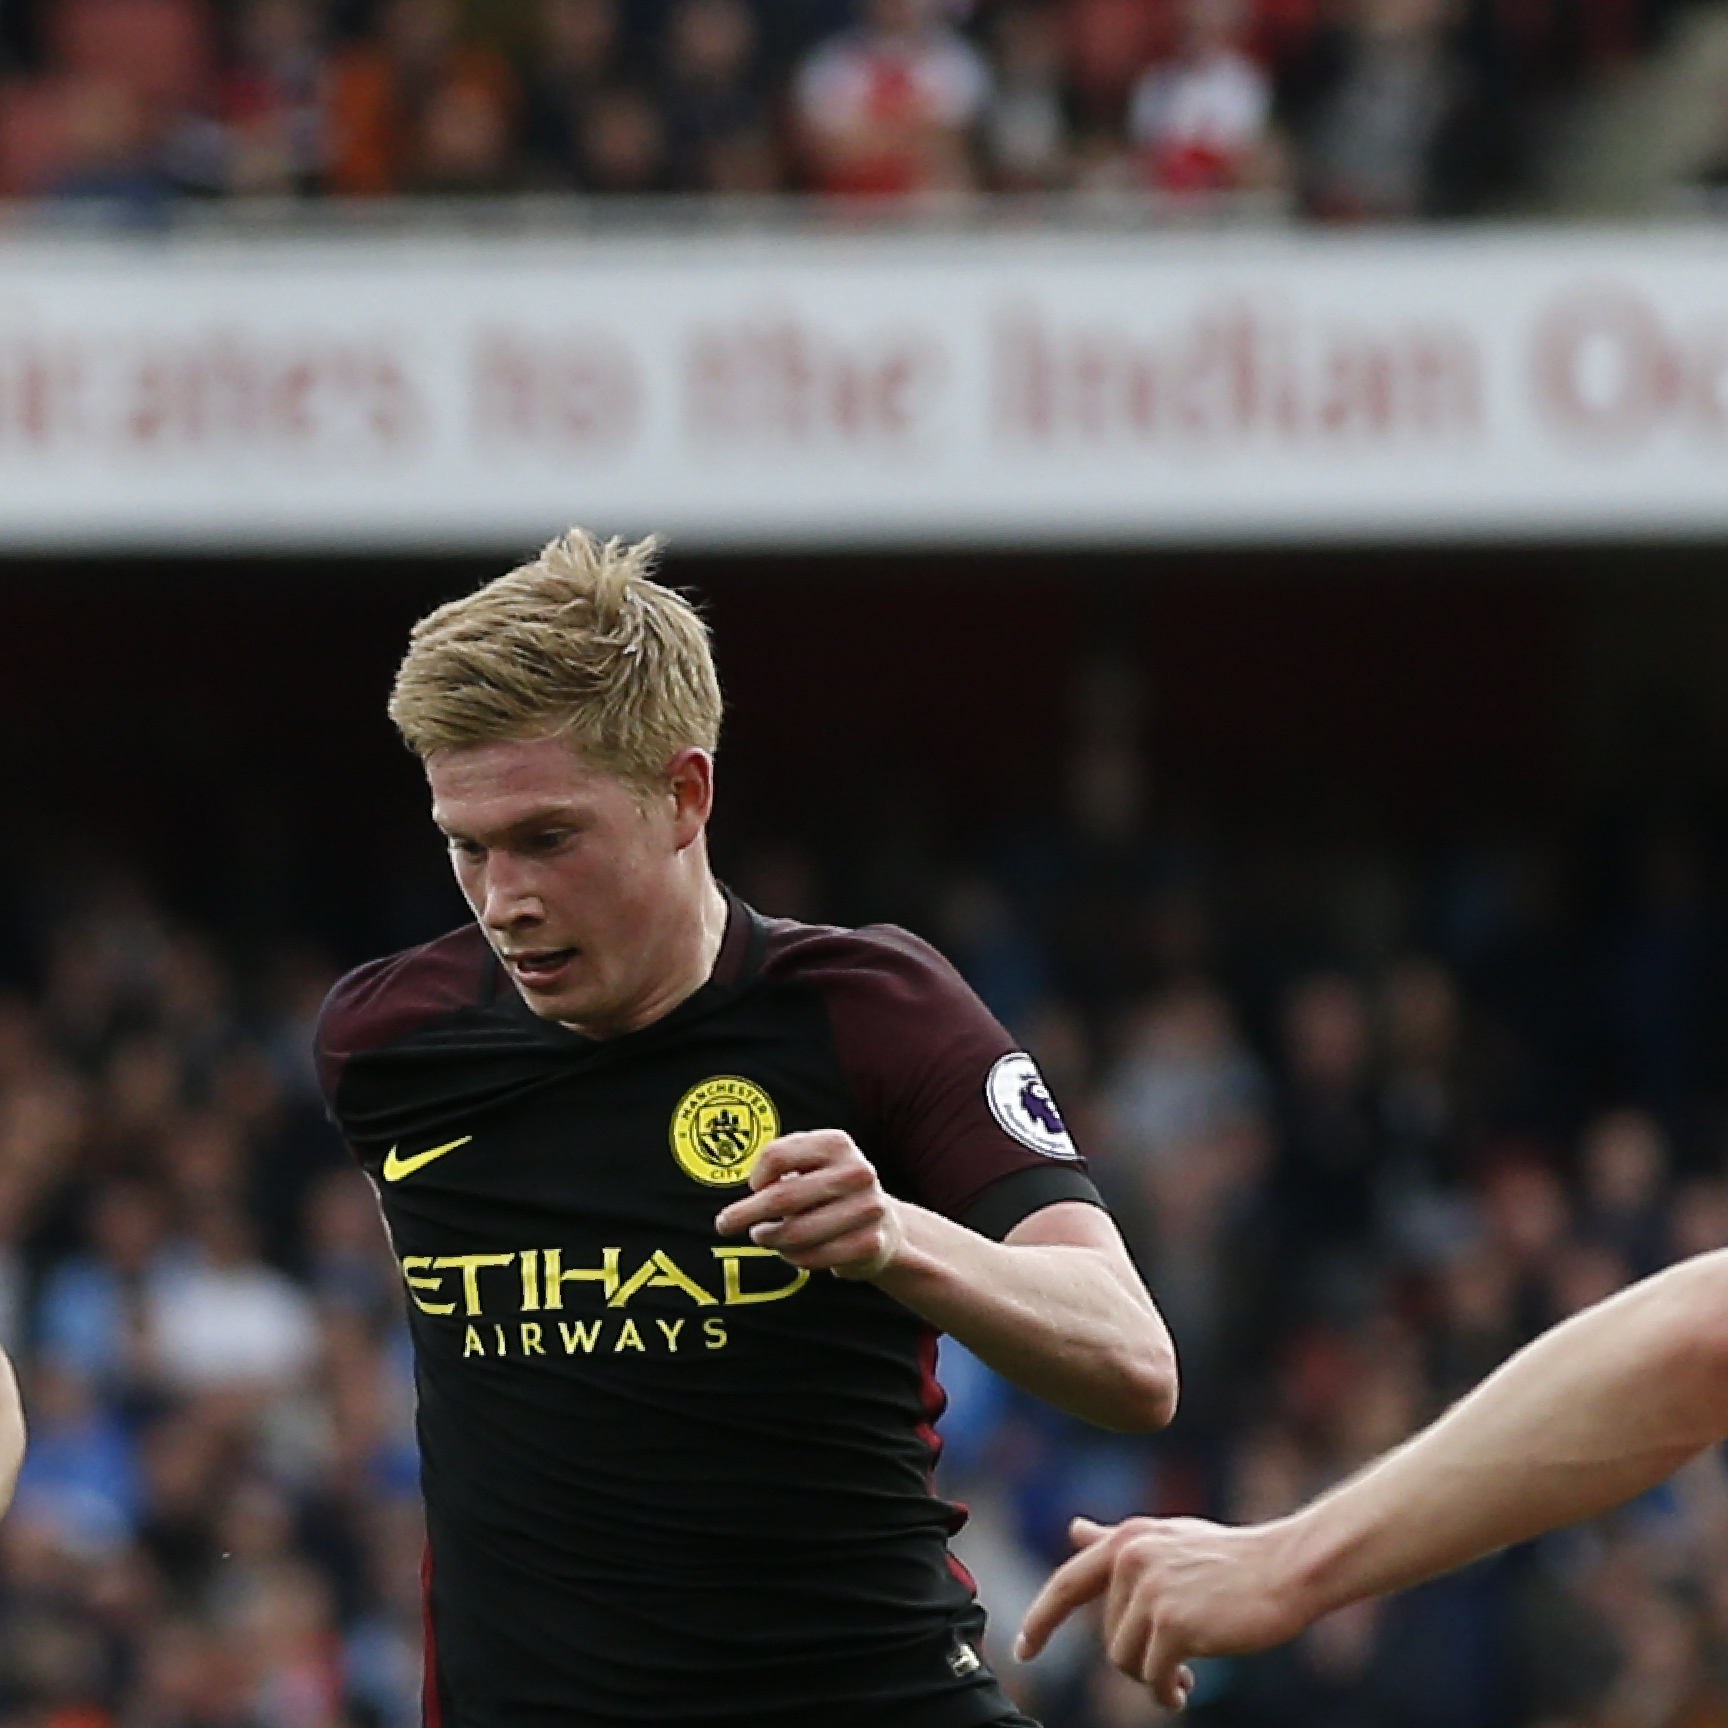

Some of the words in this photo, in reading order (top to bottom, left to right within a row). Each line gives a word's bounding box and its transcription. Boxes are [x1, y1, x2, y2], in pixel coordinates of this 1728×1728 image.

[462, 308, 646, 455] to
[678, 294, 944, 455] the
[982, 288, 1488, 455] Indian
[401, 1245, 811, 1317] ETIHAD
[462, 1318, 729, 1358] AIRWAYS
